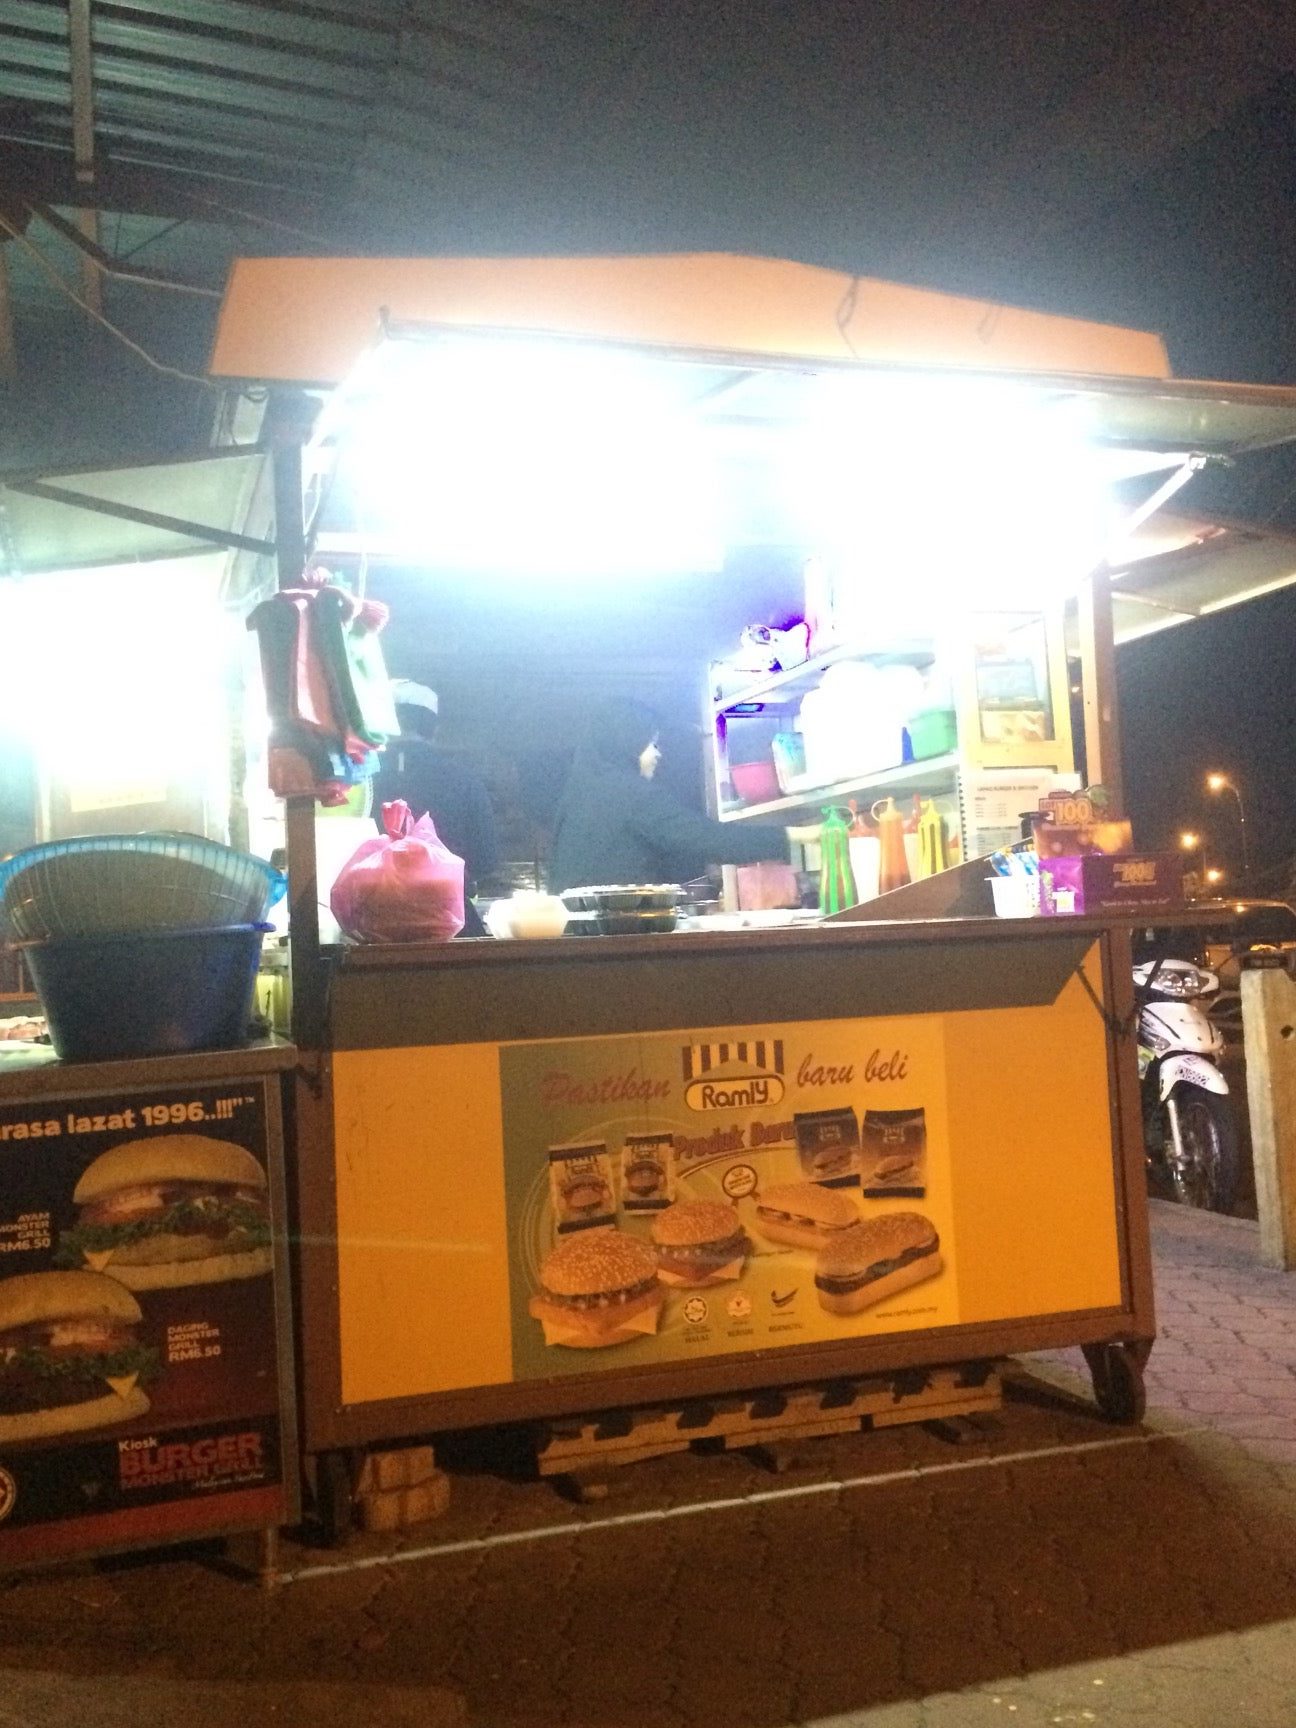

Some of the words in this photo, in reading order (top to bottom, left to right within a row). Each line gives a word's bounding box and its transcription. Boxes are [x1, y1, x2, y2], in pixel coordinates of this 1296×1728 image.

[539, 1067, 671, 1106] Pastikan
[702, 1080, 769, 1109] Ramly
[797, 1053, 854, 1088] baru
[864, 1048, 908, 1082] beli
[67, 1109, 135, 1134] lazat
[168, 1328, 220, 1341] MONSTER
[118, 1437, 158, 1452] Kiosk
[120, 1432, 262, 1475] BURGER
